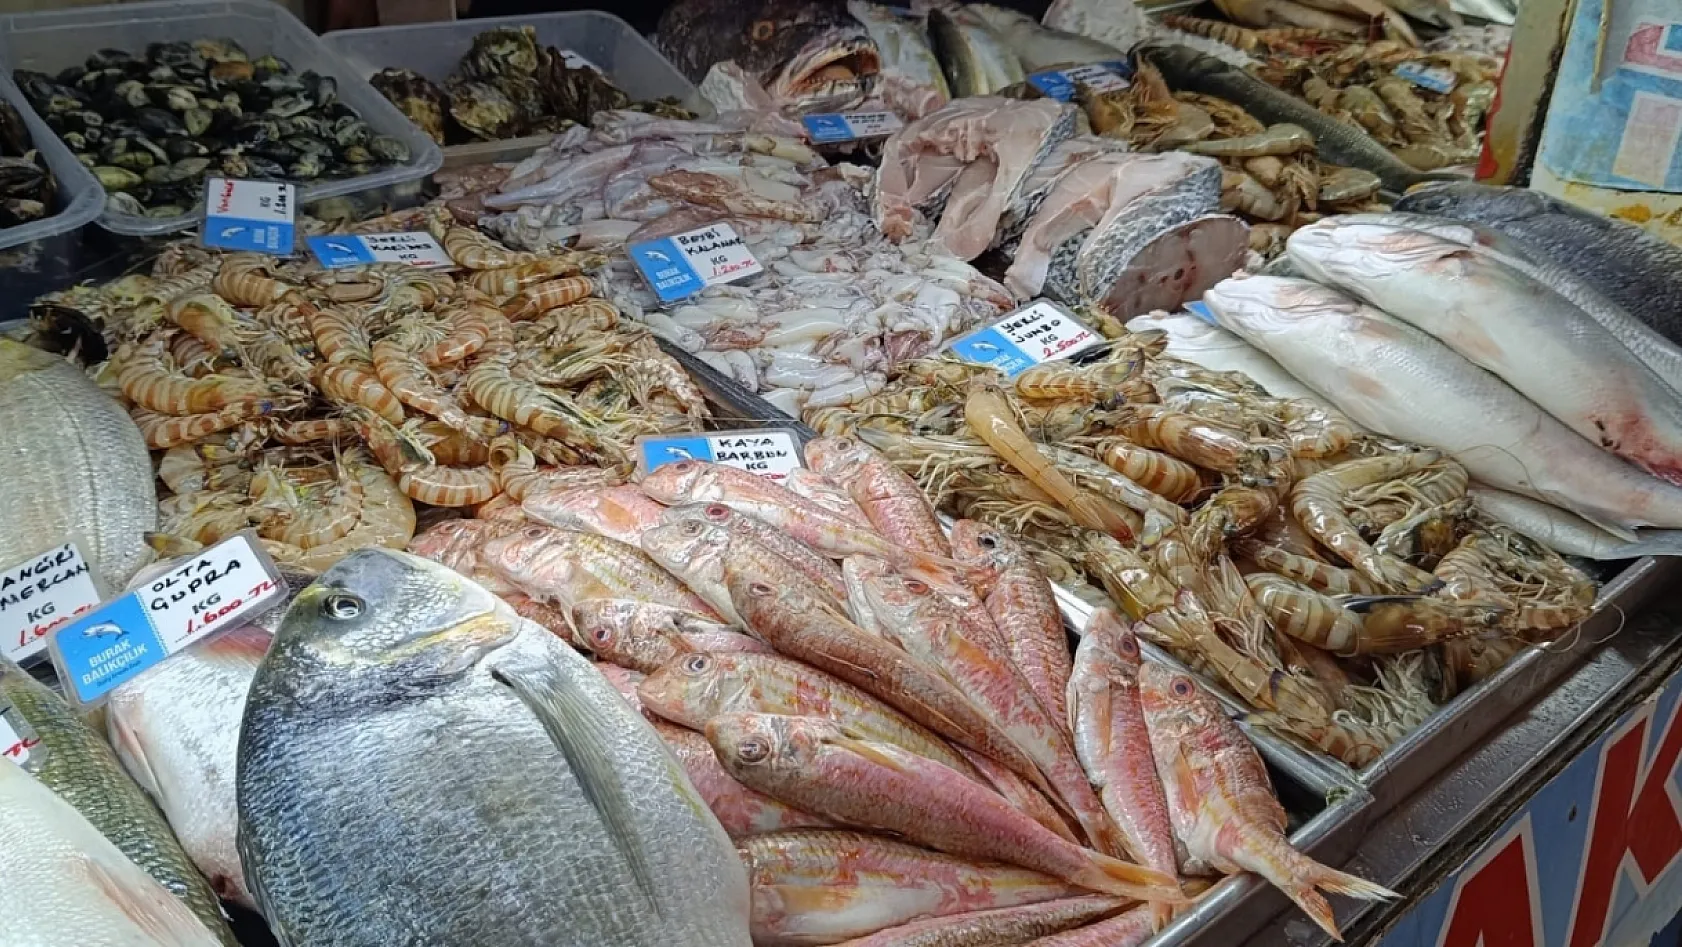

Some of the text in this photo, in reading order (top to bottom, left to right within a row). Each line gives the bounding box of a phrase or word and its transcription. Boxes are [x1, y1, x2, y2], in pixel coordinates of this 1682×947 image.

[711, 255, 728, 265] KG
[1040, 333, 1059, 345] KG
[719, 438, 774, 448] KAYA
[745, 462, 769, 471] KG
[152, 559, 212, 593] OLTA
[27, 601, 55, 624] KG
[192, 592, 221, 615] KG
[187, 598, 242, 635] 1.600
[82, 642, 149, 685] BALIKÇILIK
[89, 638, 131, 668] BURAK
